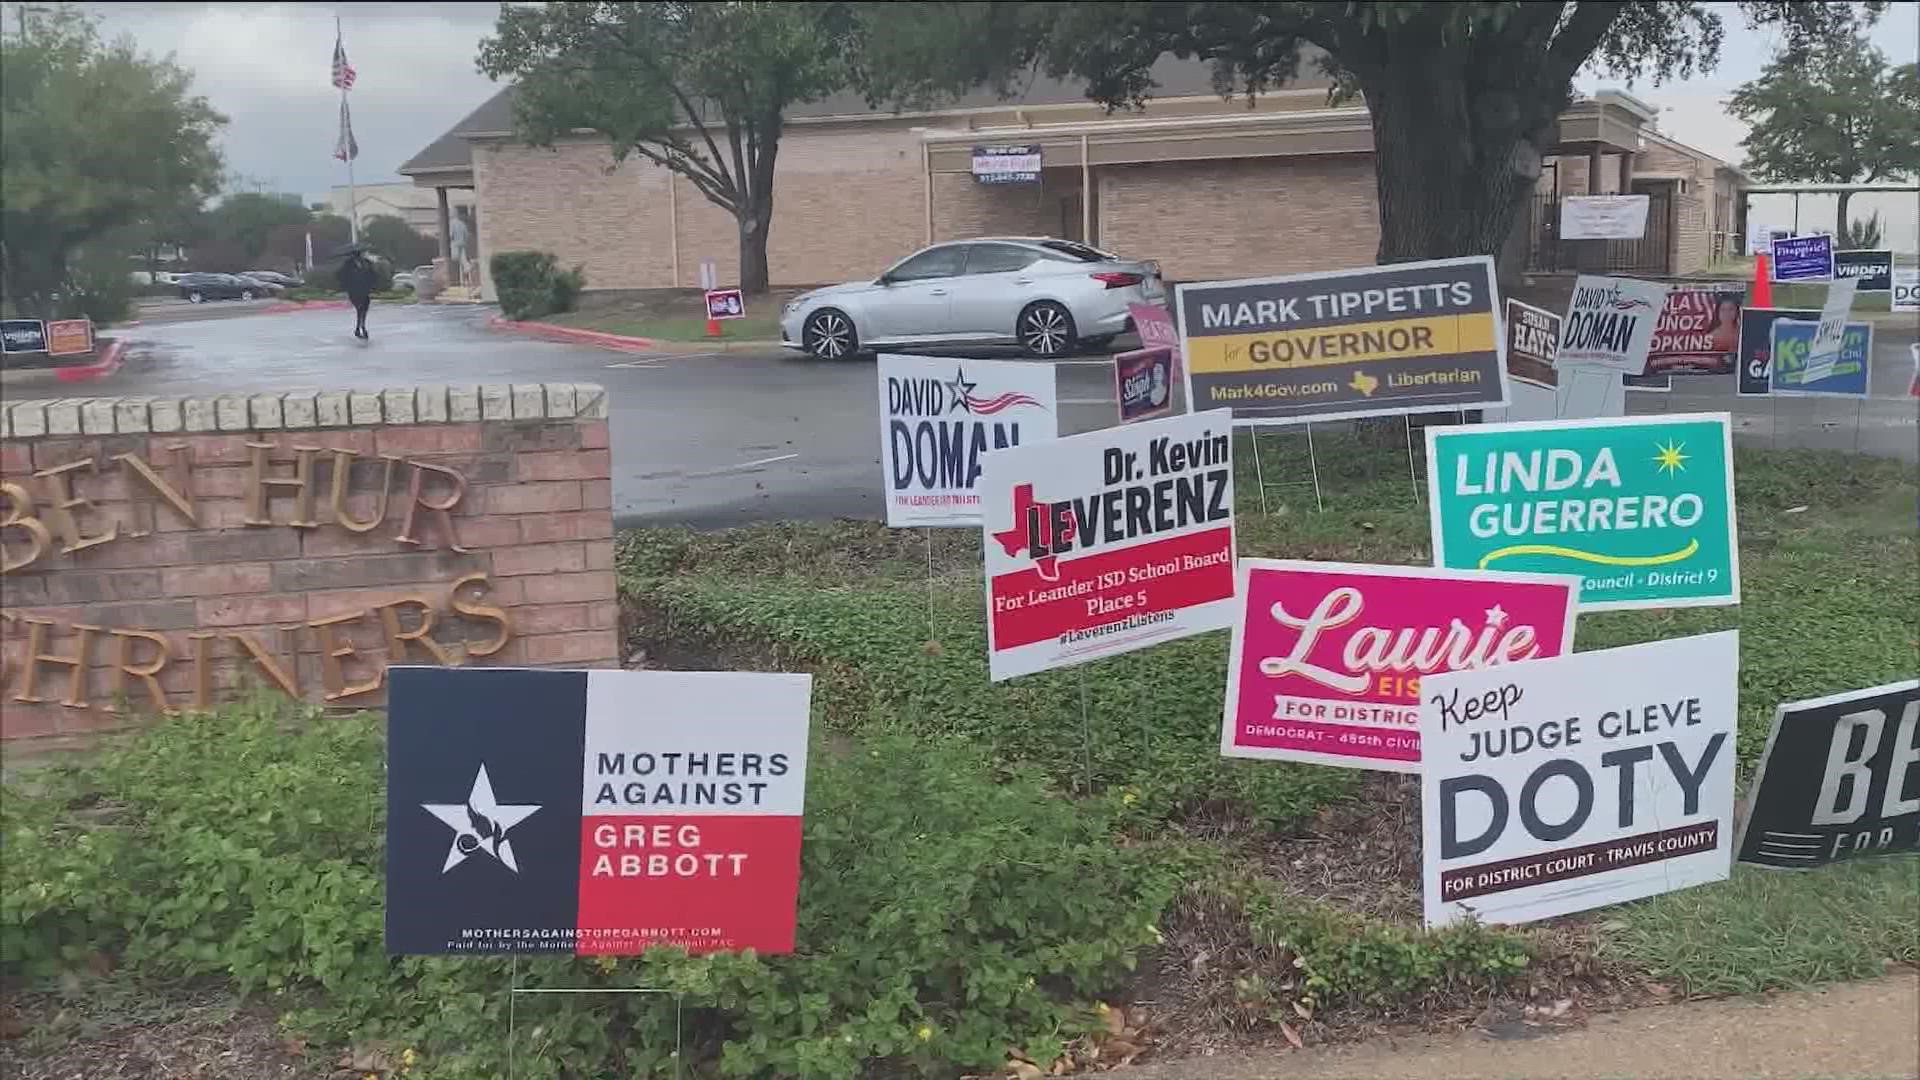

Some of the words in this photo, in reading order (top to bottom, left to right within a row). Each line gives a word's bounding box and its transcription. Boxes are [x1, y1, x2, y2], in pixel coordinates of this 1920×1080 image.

[1202, 298, 1300, 328] MARK
[1306, 281, 1472, 320] TIPPETTS
[1575, 287, 1604, 309] DAVID
[1248, 326, 1434, 364] GOVERNOR
[1514, 323, 1556, 360] HAYS
[1563, 312, 1636, 353] DOMAN
[889, 377, 943, 416] DAVID
[1210, 381, 1338, 401] Mark4Gov.com
[1387, 367, 1481, 389] Libertarian
[1104, 447, 1143, 487] Dr.
[1150, 430, 1229, 476] Kevin
[1455, 448, 1622, 496] LINDA
[0, 444, 199, 571] BEN
[245, 441, 481, 553] HUR
[1027, 469, 1230, 559] LEVERENZ
[1469, 492, 1704, 538] GUERRERO
[995, 596, 1026, 613] For
[1028, 579, 1094, 605] Leander
[1097, 571, 1126, 591] ISD
[1129, 560, 1180, 583] School
[1184, 547, 1230, 571] Board
[1646, 570, 1704, 587] District
[1707, 569, 1718, 584] 9
[1087, 593, 1134, 617] Place
[1137, 590, 1147, 607] 5
[0, 571, 511, 716] HRINERS
[1059, 609, 1176, 646] #LeverenzListens
[1259, 587, 1541, 695] Laurie
[1285, 702, 1326, 720] FOR
[1335, 706, 1418, 725] DISTRIC
[1431, 683, 1523, 732] Keep
[1245, 725, 1324, 742] DEMOCRAT
[1460, 717, 1582, 762] JUDGE
[1597, 698, 1702, 739] CLEVE
[597, 752, 790, 777] MOTHERS
[595, 783, 767, 806] AGAINST
[1439, 732, 1728, 860] DOTY
[593, 825, 701, 848] GREG
[1830, 827, 1893, 859] FOR
[592, 854, 749, 877] ABBOTT
[1445, 876, 1473, 894] FOR
[1478, 863, 1542, 888] DISTRICT
[1546, 852, 1594, 875] COURT
[1606, 840, 1655, 863] TRAVIS
[1658, 830, 1716, 851] COUNTY
